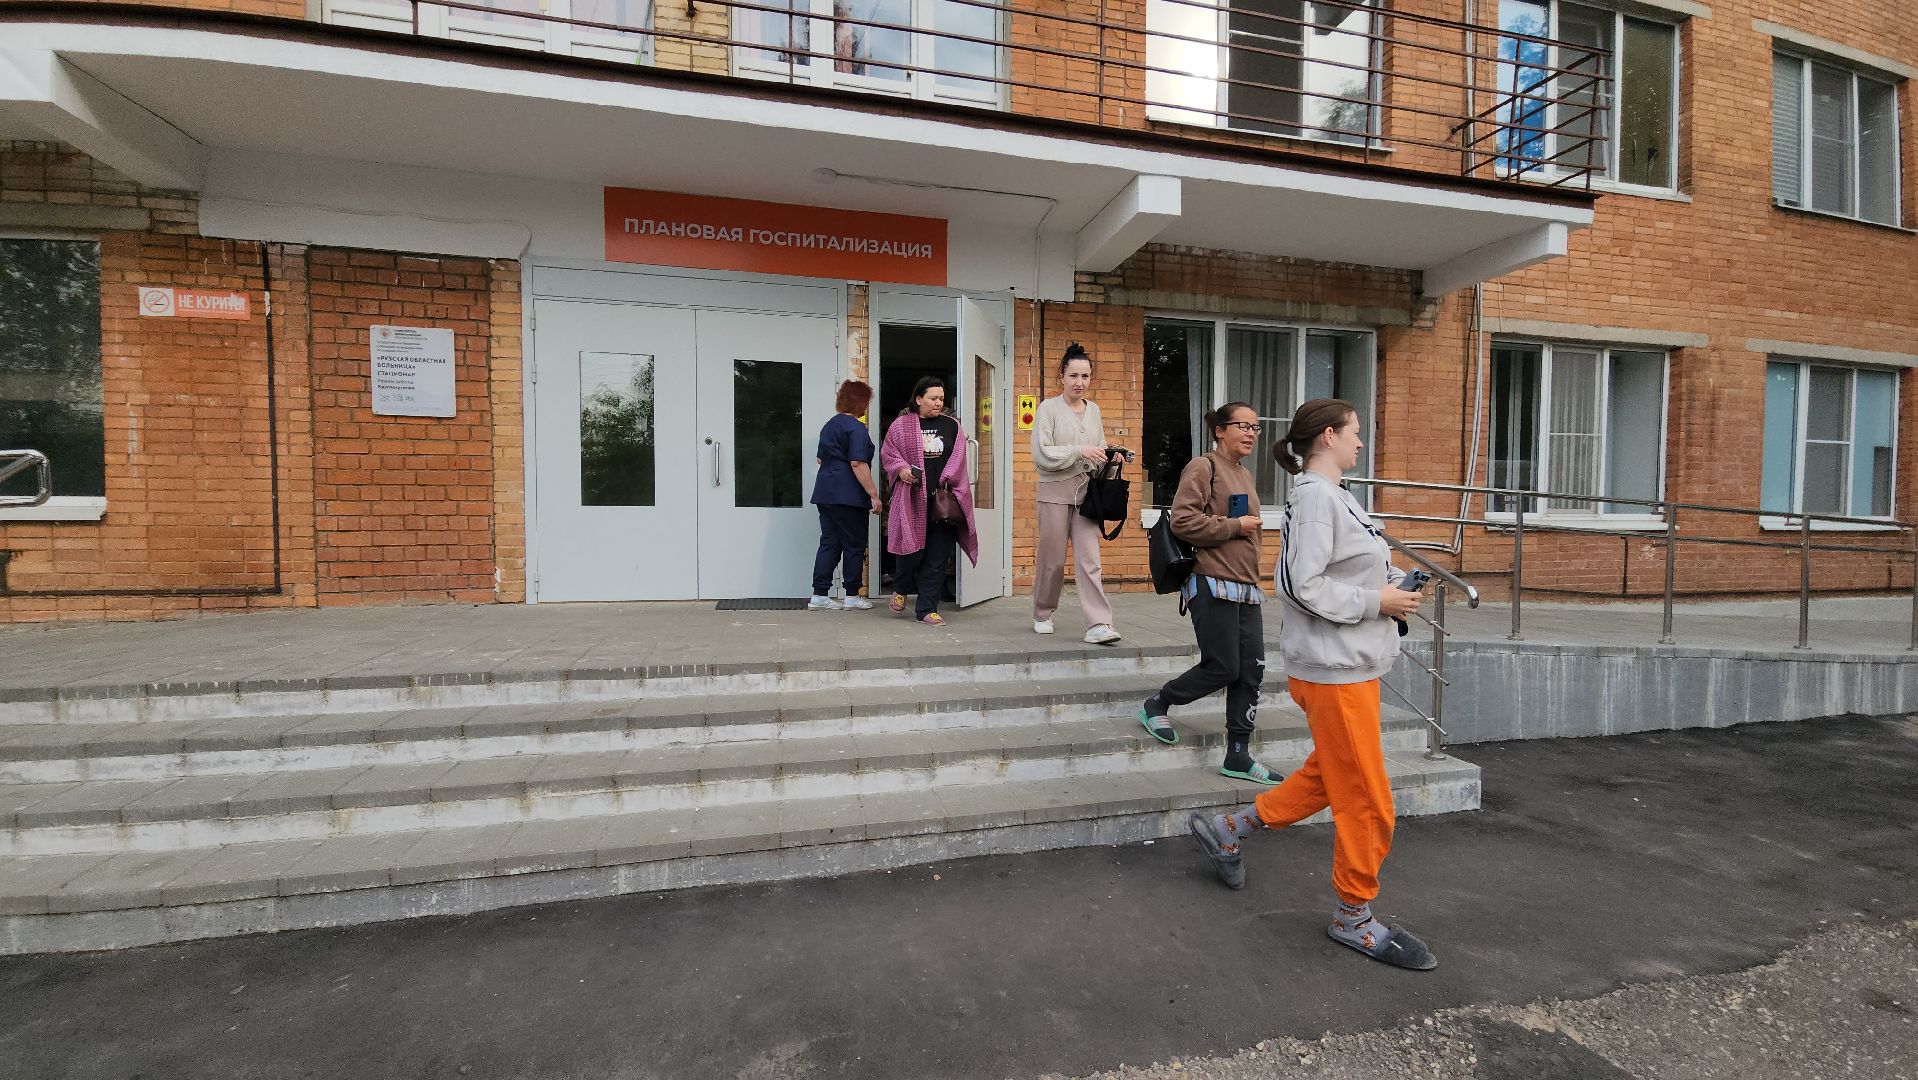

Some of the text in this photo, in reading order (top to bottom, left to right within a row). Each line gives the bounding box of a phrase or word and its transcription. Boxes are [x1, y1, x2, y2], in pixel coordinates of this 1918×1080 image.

[624, 217, 932, 259] ПЛАНОВАЯ ГОСПИТАЛИЗАЦИЯ
[178, 294, 193, 308] НЕ
